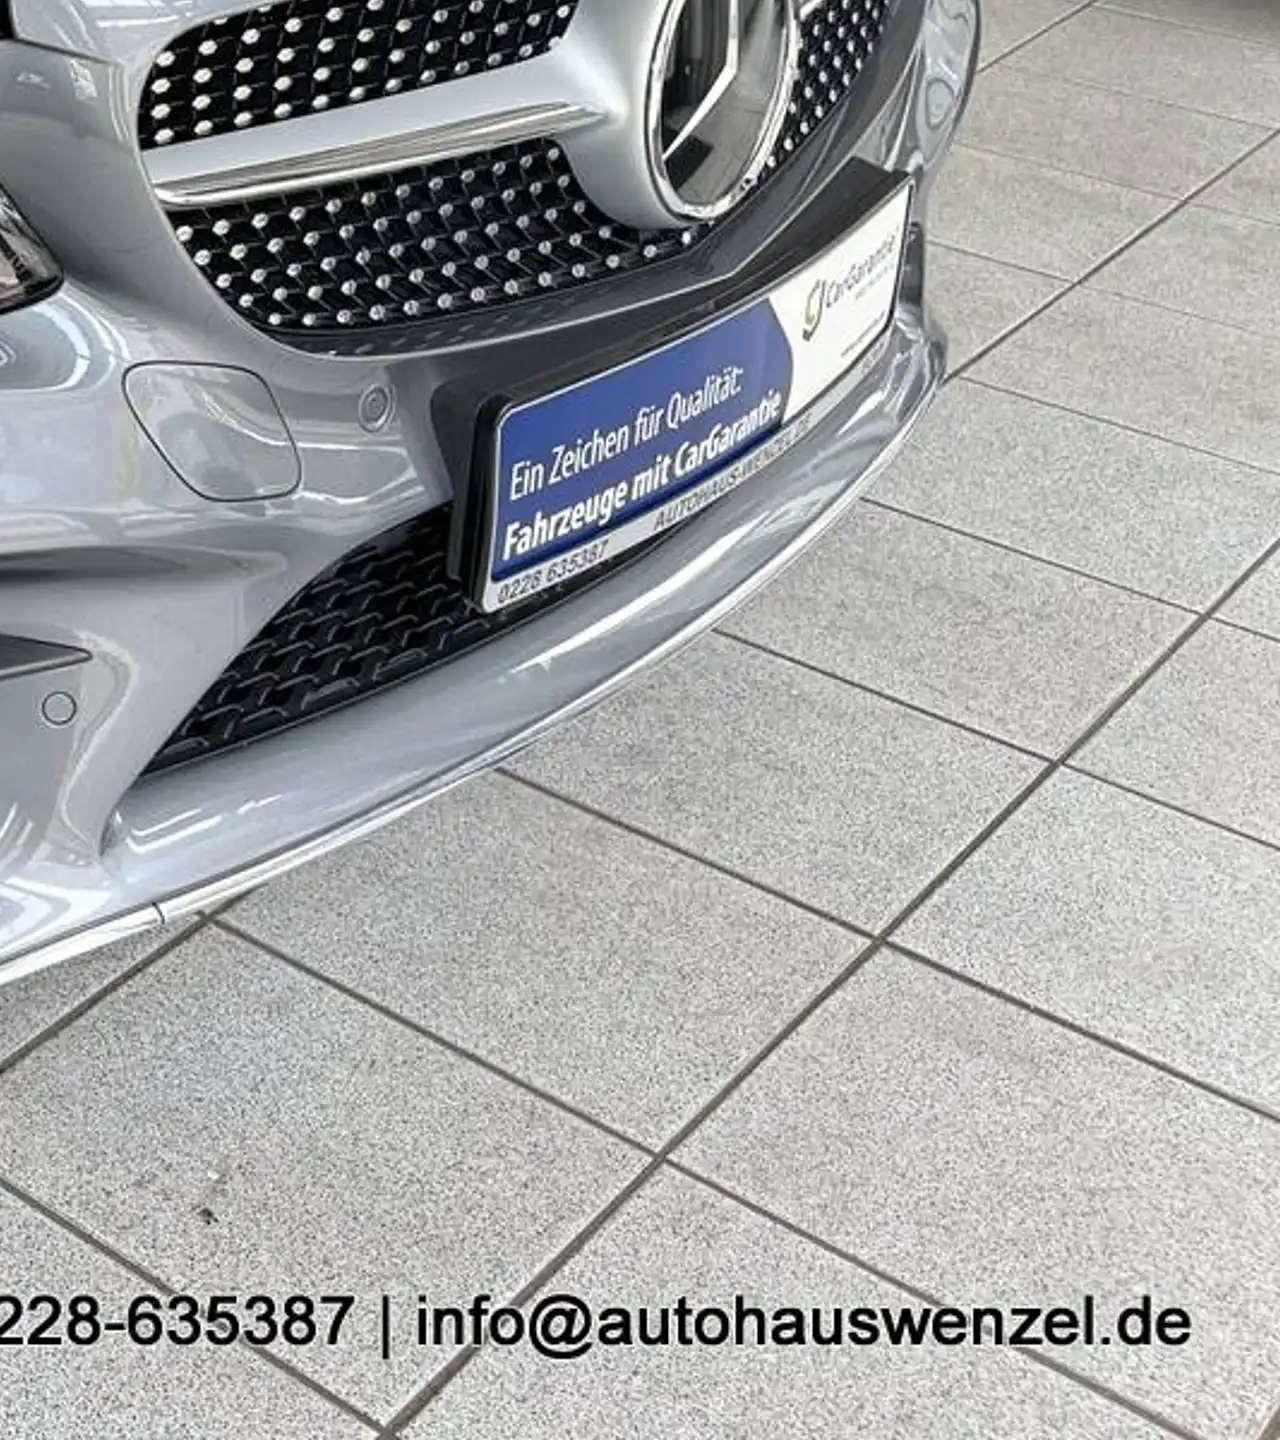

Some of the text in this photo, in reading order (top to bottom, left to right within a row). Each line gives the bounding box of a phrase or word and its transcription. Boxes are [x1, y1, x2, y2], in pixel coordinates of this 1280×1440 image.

[502, 388, 782, 561] Fahrzeuge mit CarGarantie
[510, 460, 544, 501] Ein
[548, 424, 630, 486] Zeichen
[634, 404, 664, 446] für
[497, 569, 542, 604] 0228
[546, 539, 610, 585] 635387
